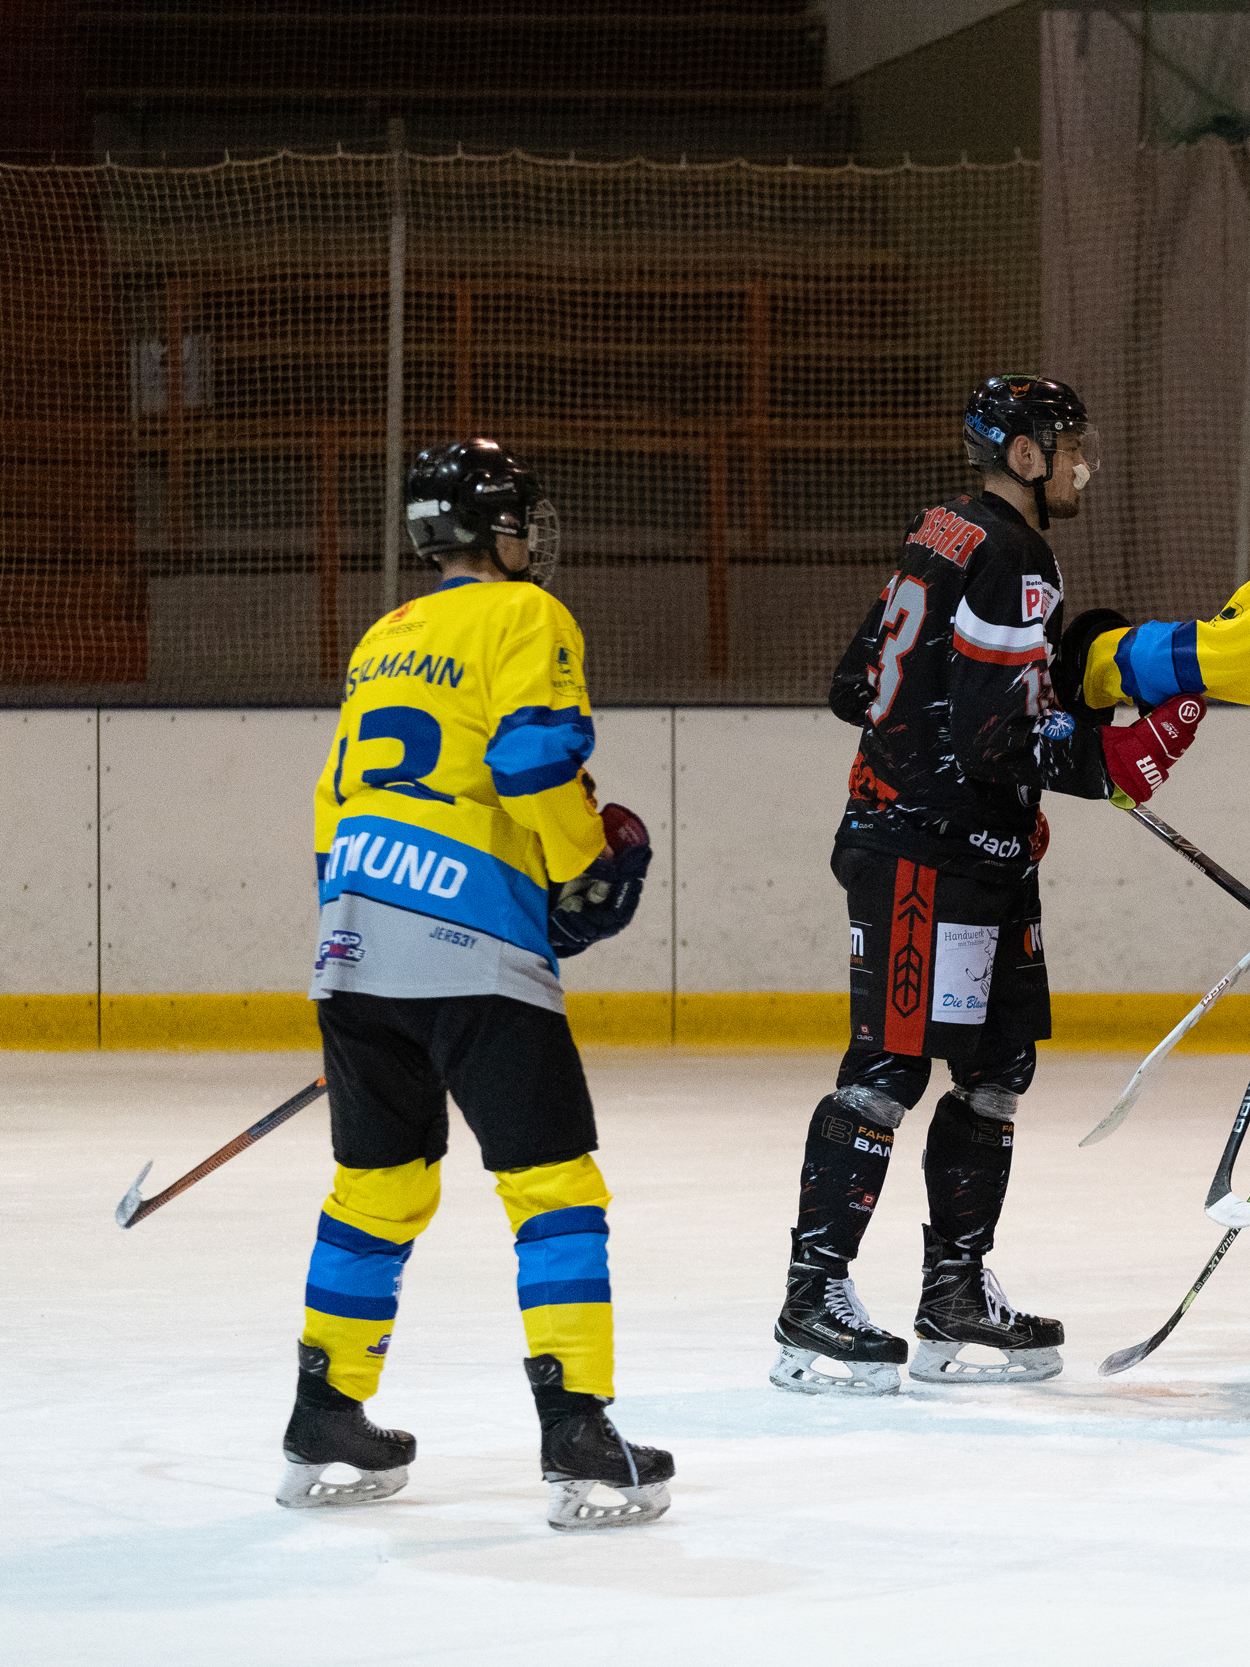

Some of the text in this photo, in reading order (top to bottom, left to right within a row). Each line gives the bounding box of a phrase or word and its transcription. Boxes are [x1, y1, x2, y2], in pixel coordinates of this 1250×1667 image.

[968, 829, 1021, 859] dach
[944, 929, 985, 942] Handwerk
[942, 993, 962, 1009] Die
